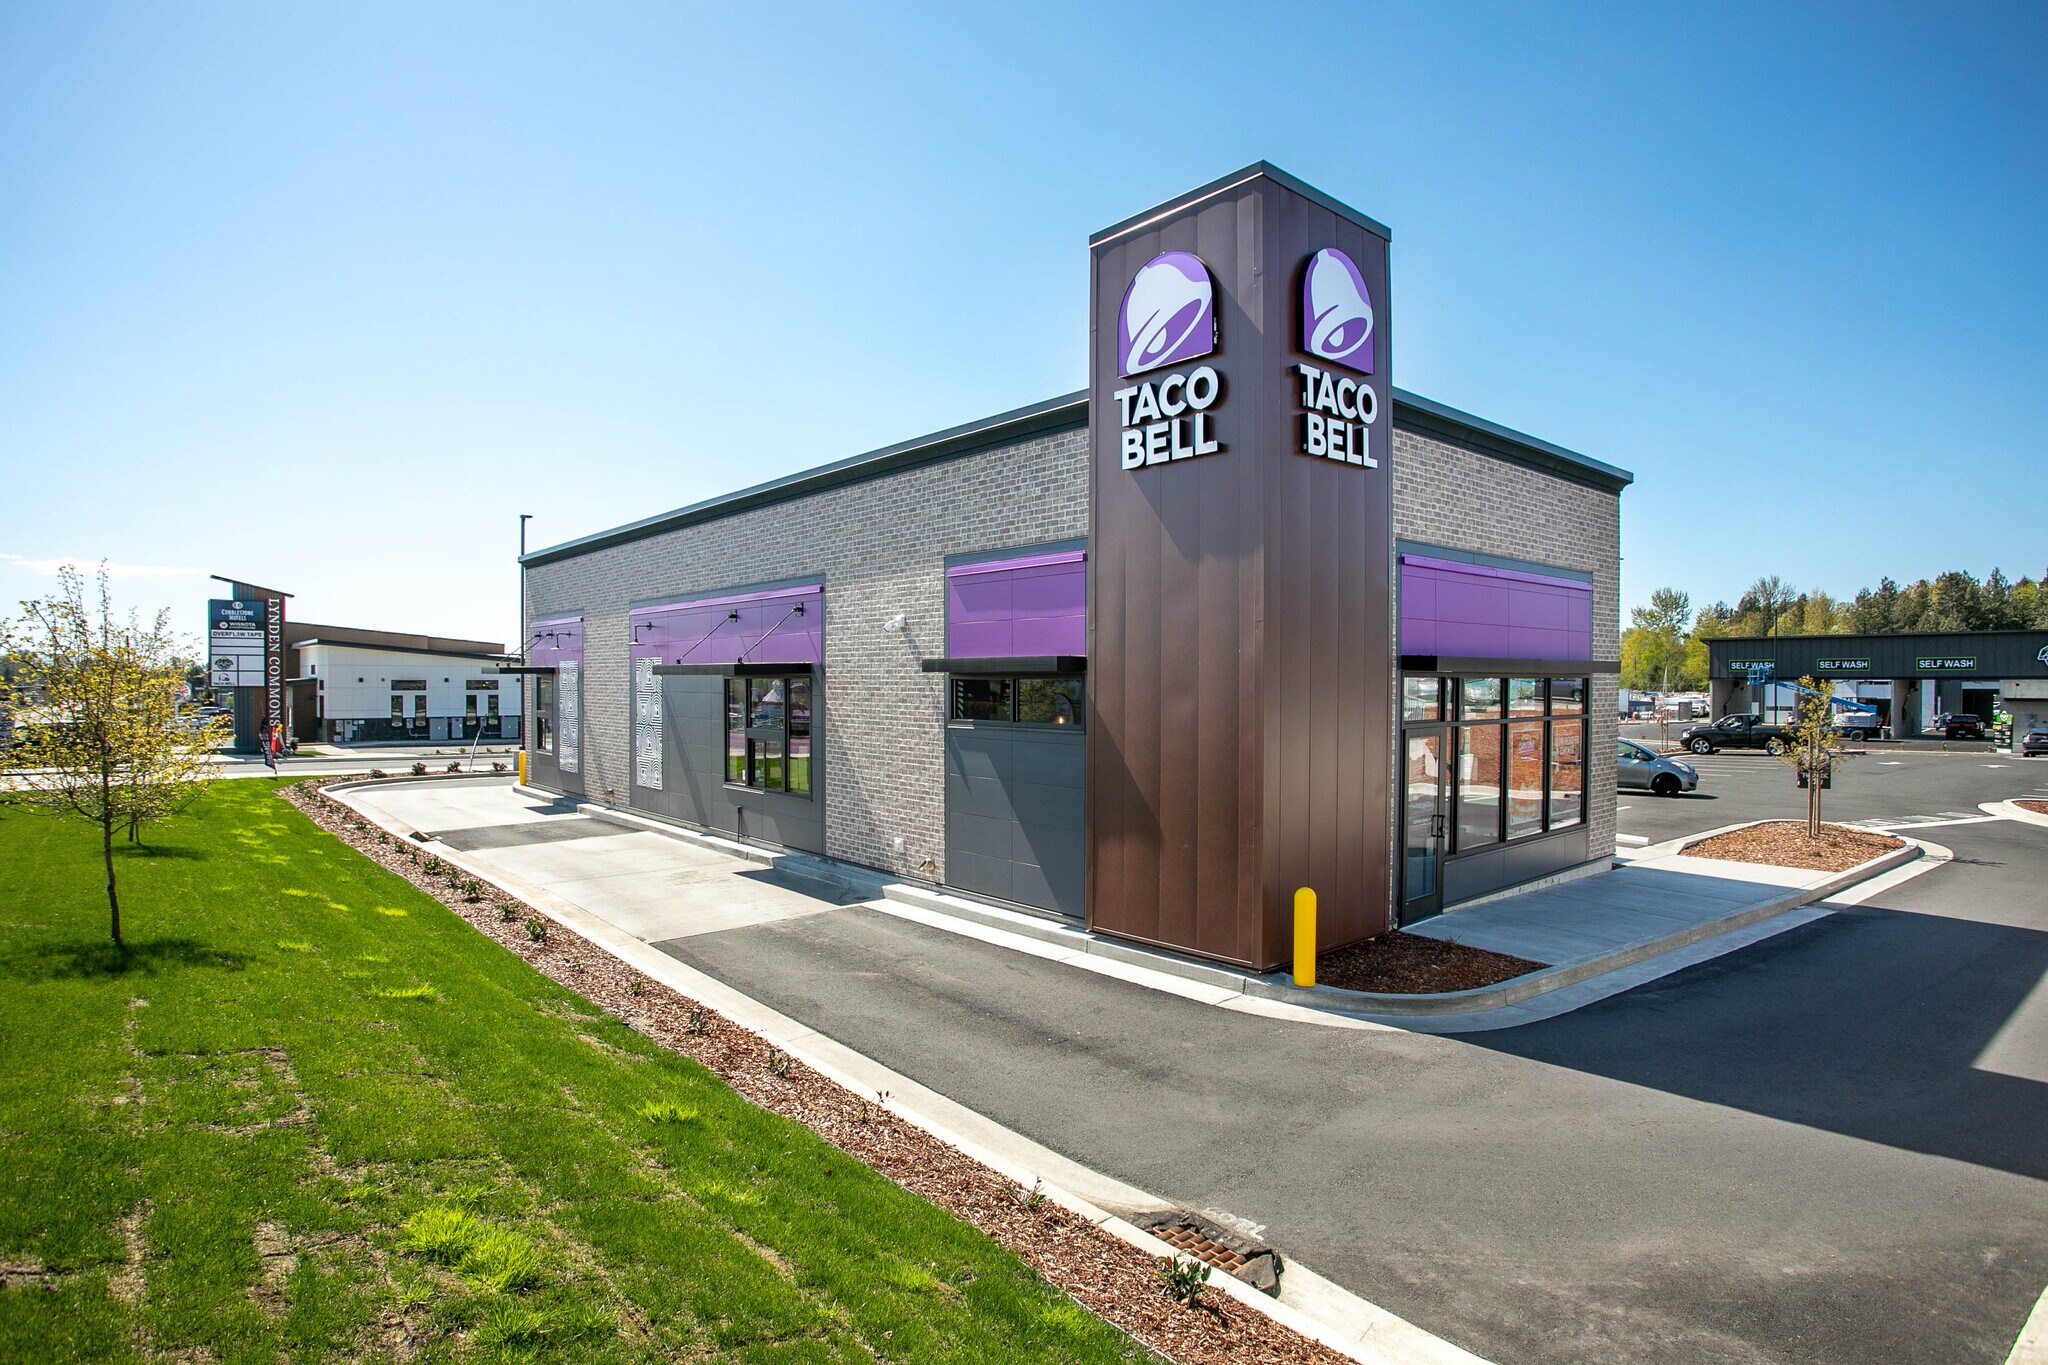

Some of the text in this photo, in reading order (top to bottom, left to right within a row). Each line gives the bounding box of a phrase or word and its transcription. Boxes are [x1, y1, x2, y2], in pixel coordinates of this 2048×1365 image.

[1114, 366, 1219, 427] TACO
[1298, 364, 1378, 425] TACO
[1121, 412, 1218, 470] BELL
[1307, 413, 1378, 469] BELL
[269, 599, 281, 726] LYNDEN COMMONS
[1819, 661, 1868, 669] SELF WASH
[1919, 660, 1974, 668] SELF WASH
